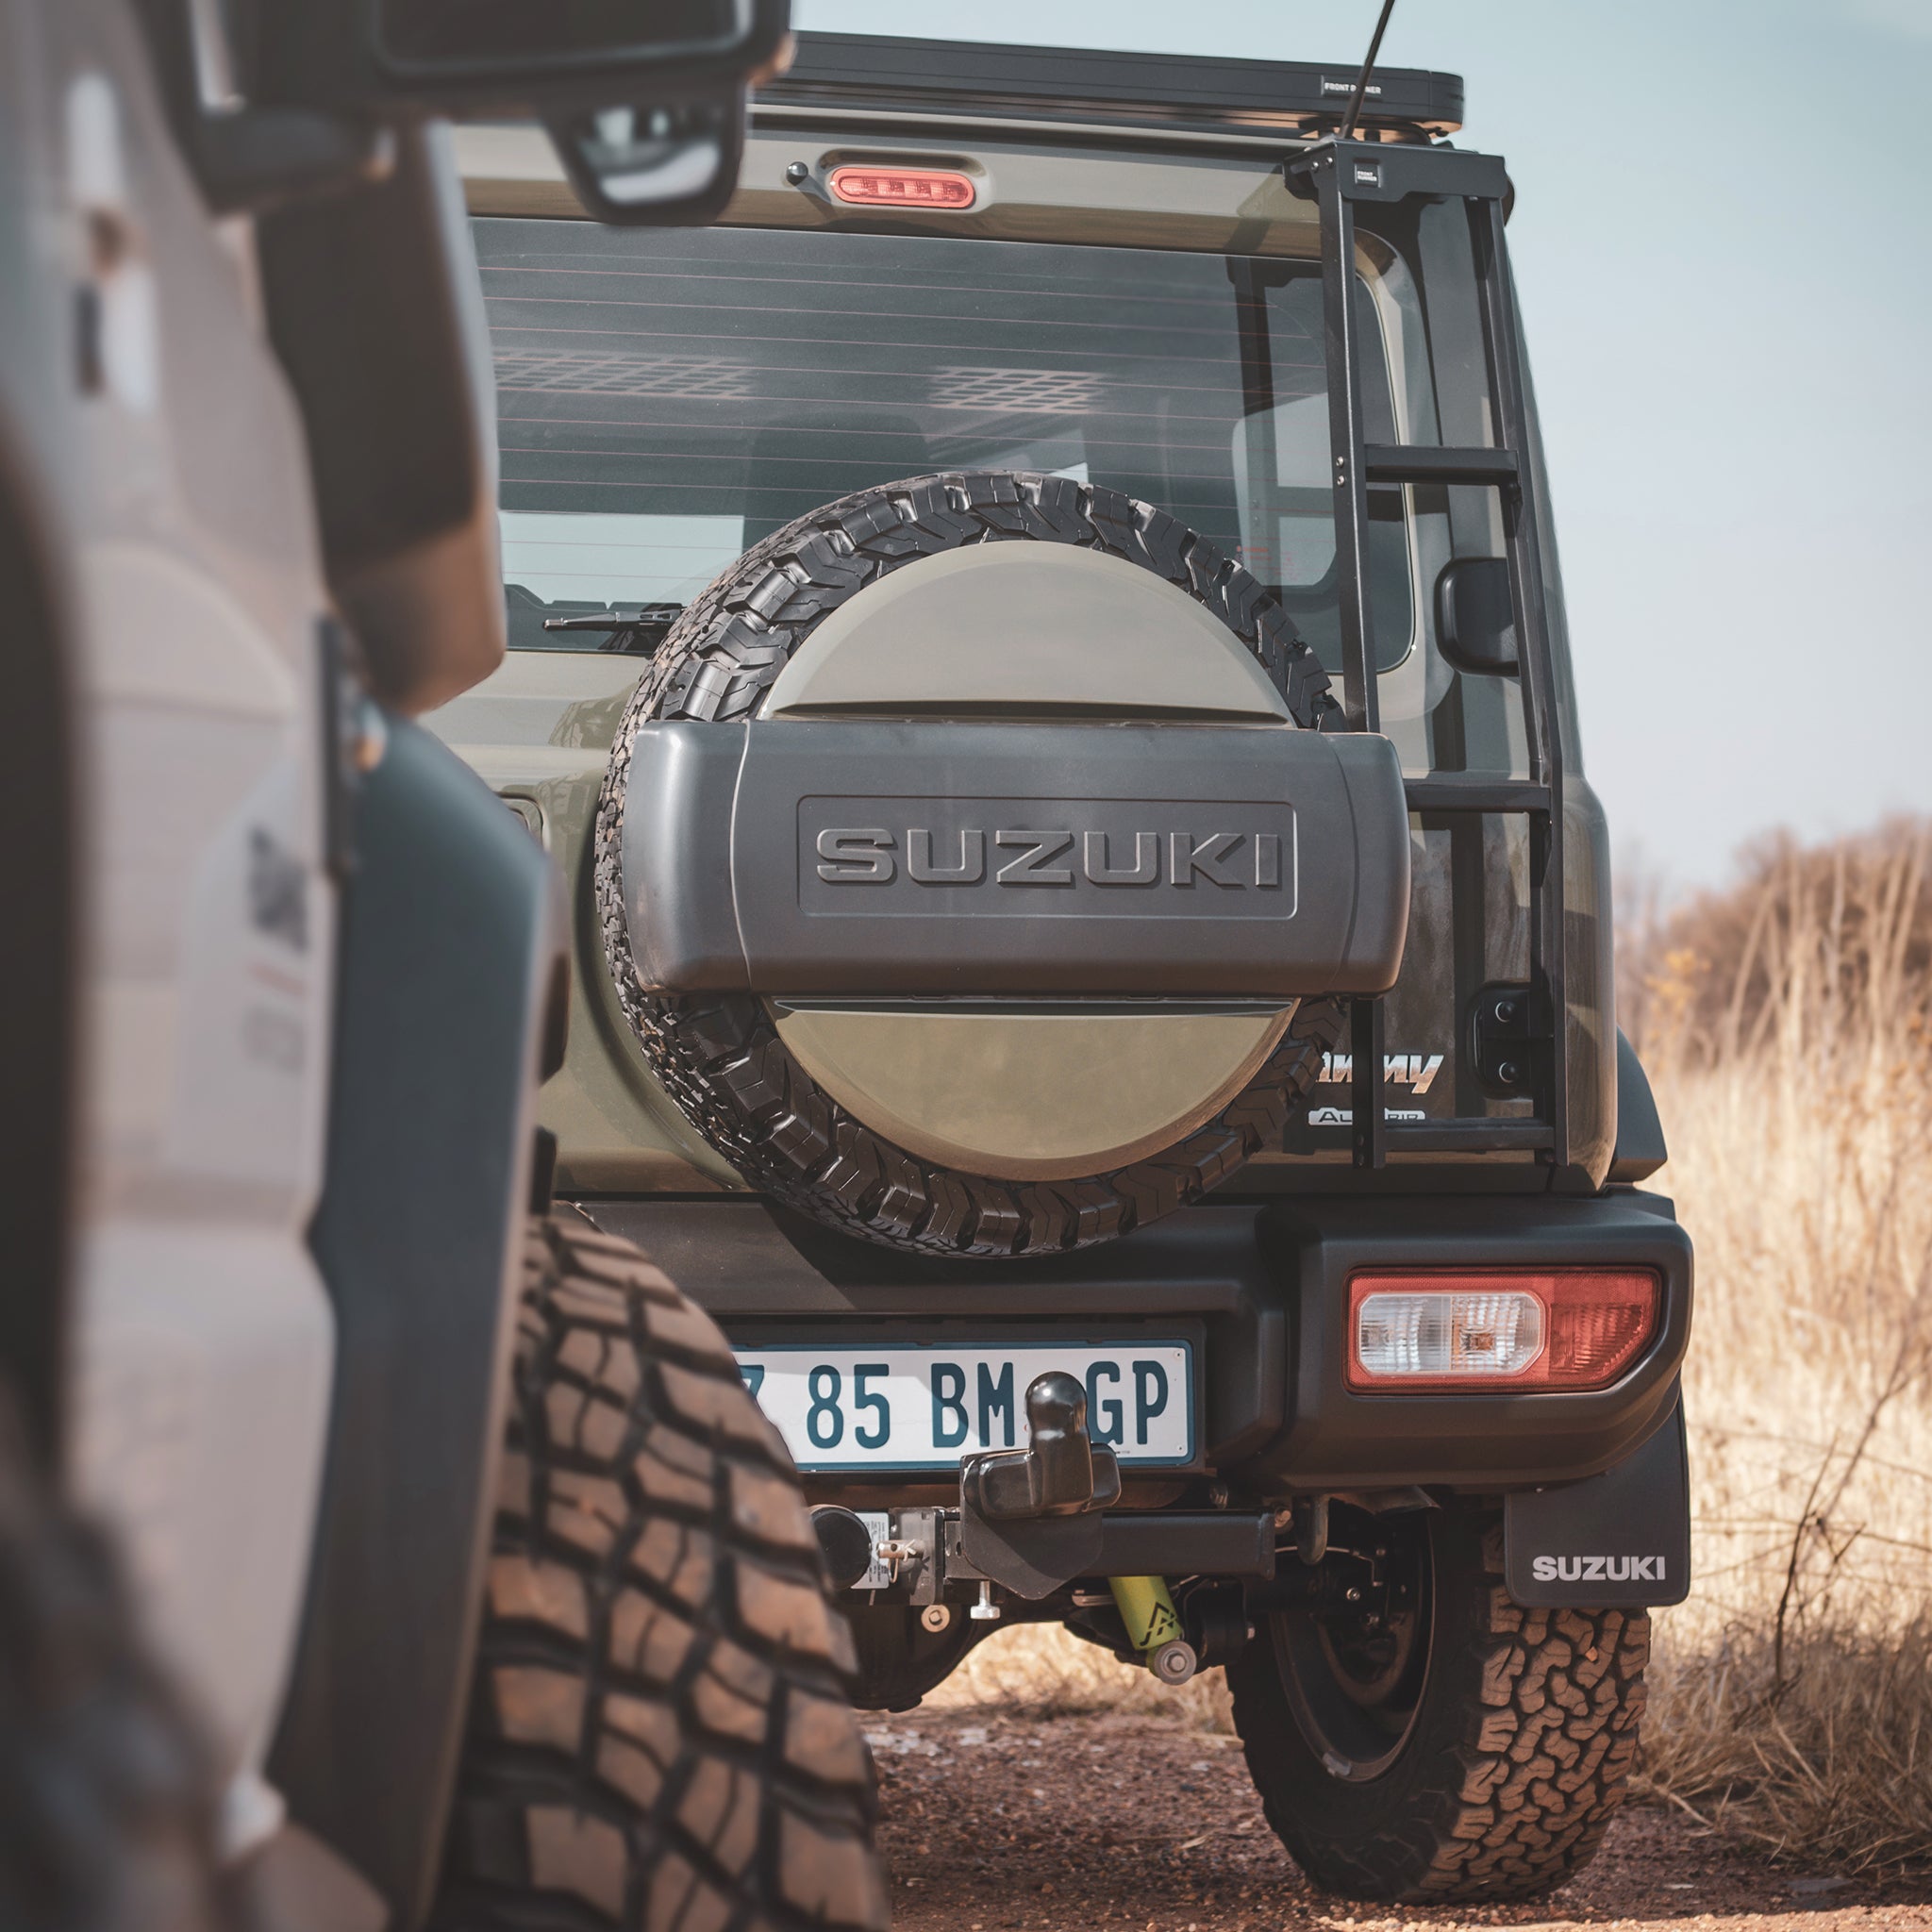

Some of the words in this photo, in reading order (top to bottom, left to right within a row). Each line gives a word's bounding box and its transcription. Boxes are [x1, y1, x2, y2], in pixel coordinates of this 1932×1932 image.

[1324, 82, 1349, 92] FRONT
[1350, 84, 1381, 94] RNER
[816, 828, 1279, 887] SUZUKI
[807, 1363, 891, 1450] 85
[930, 1361, 1015, 1449] BM
[1085, 1360, 1169, 1445] GP
[1532, 1556, 1667, 1582] SUZUKI
